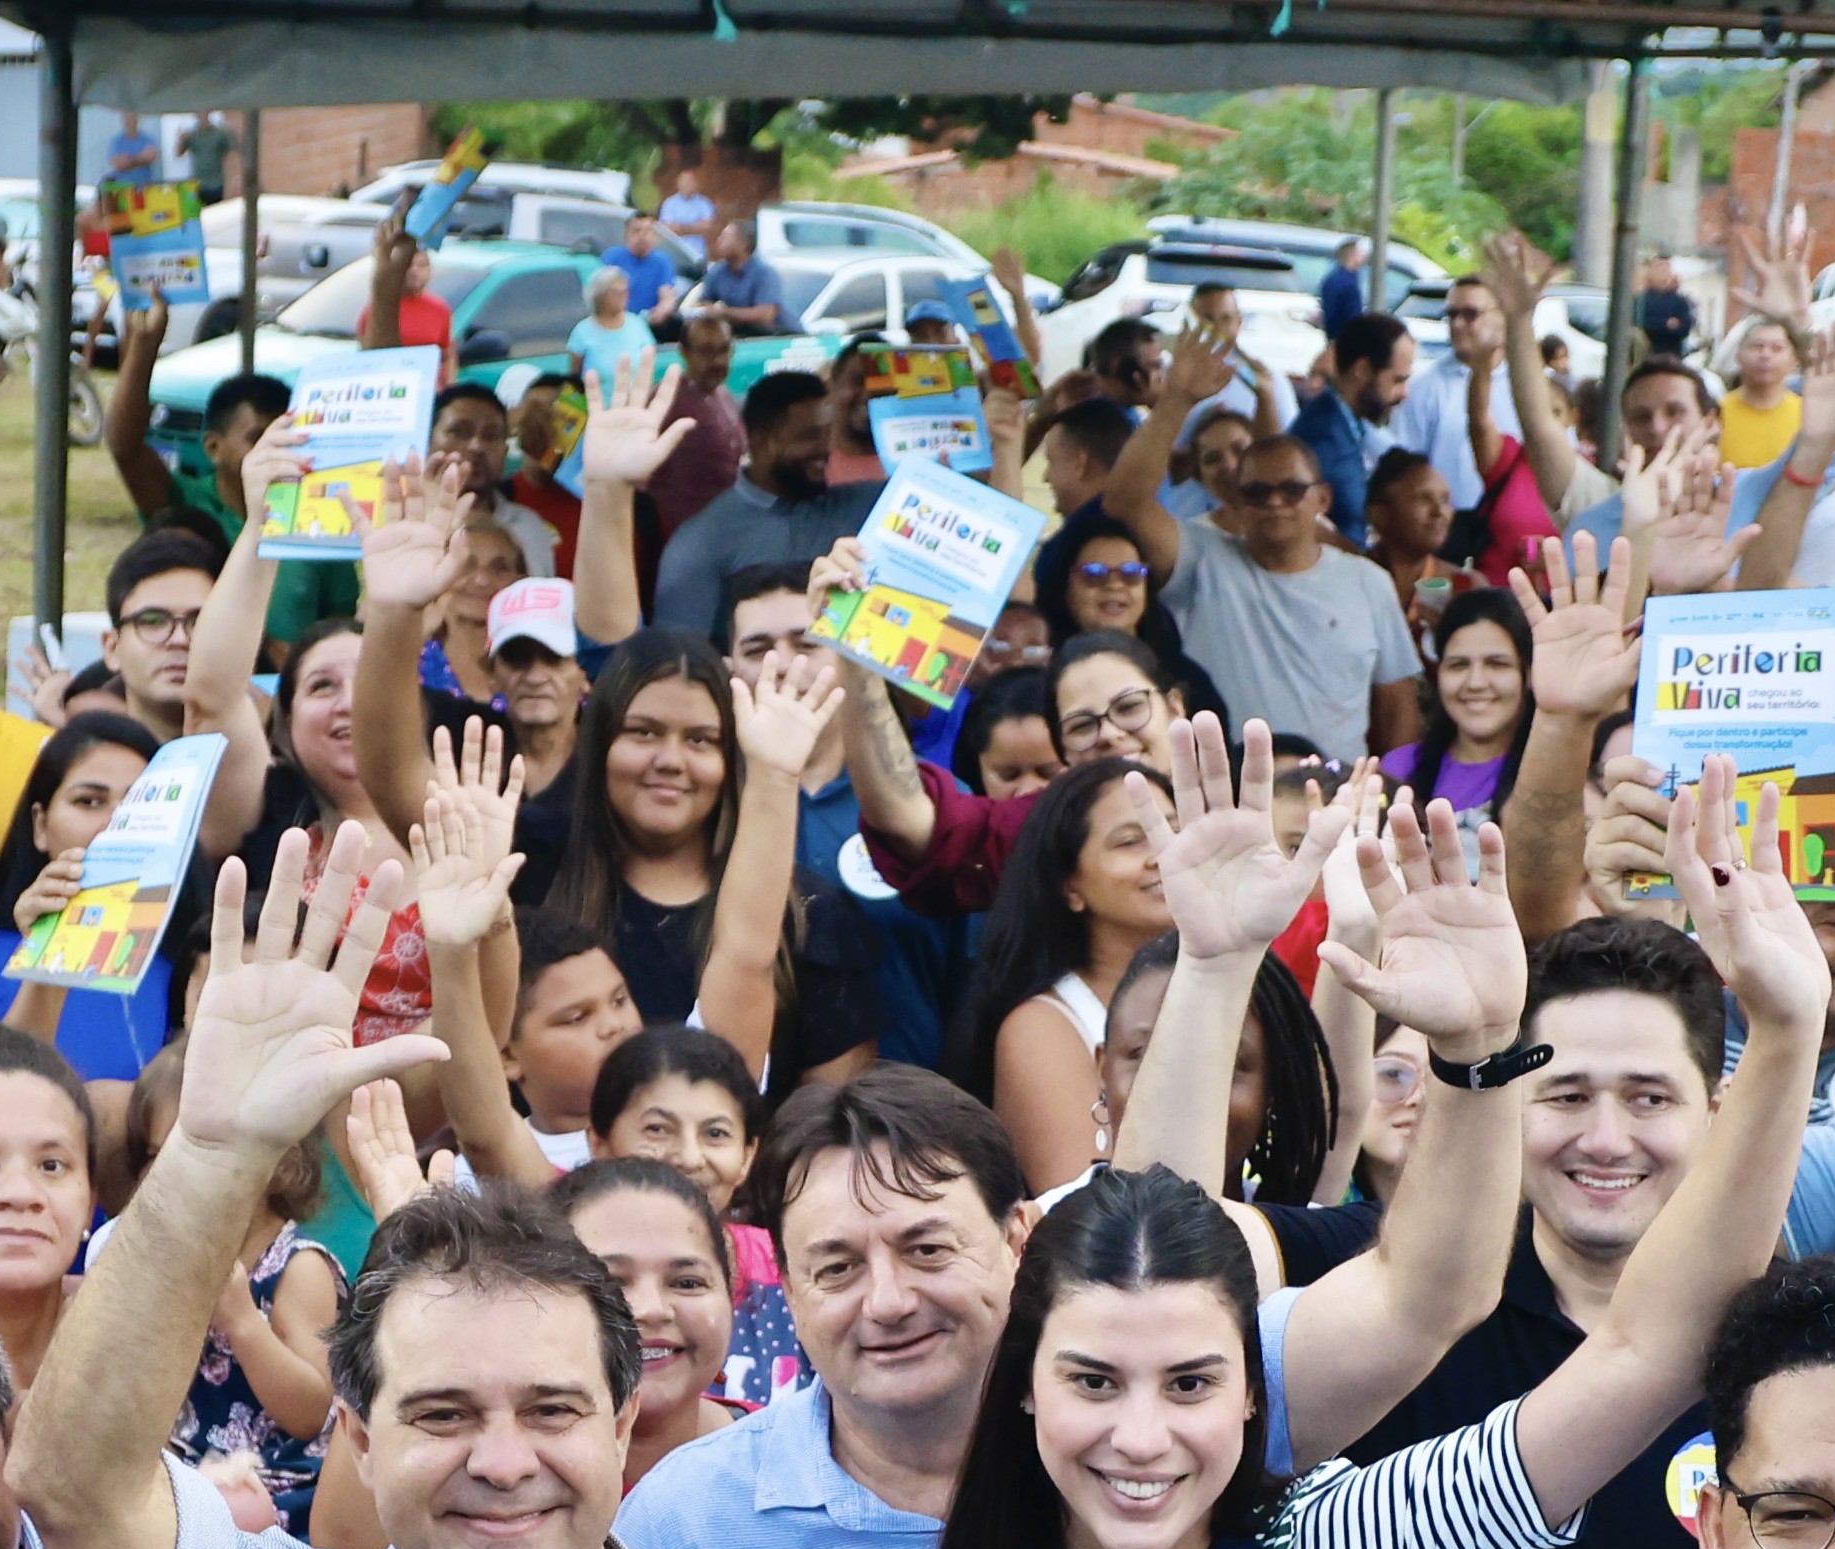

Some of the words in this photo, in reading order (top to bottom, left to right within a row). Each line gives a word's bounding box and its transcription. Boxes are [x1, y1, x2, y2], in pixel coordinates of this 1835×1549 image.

[1672, 642, 1823, 676] Periferia
[1672, 681, 1741, 710] Viva
[1747, 687, 1788, 699] chegou
[1789, 689, 1803, 697] ao
[1746, 701, 1766, 710] seu
[1669, 728, 1696, 738] Fique
[1697, 728, 1714, 738] por
[1716, 727, 1750, 737] dentro
[1760, 726, 1809, 739] participe
[1683, 740, 1713, 749] dessa
